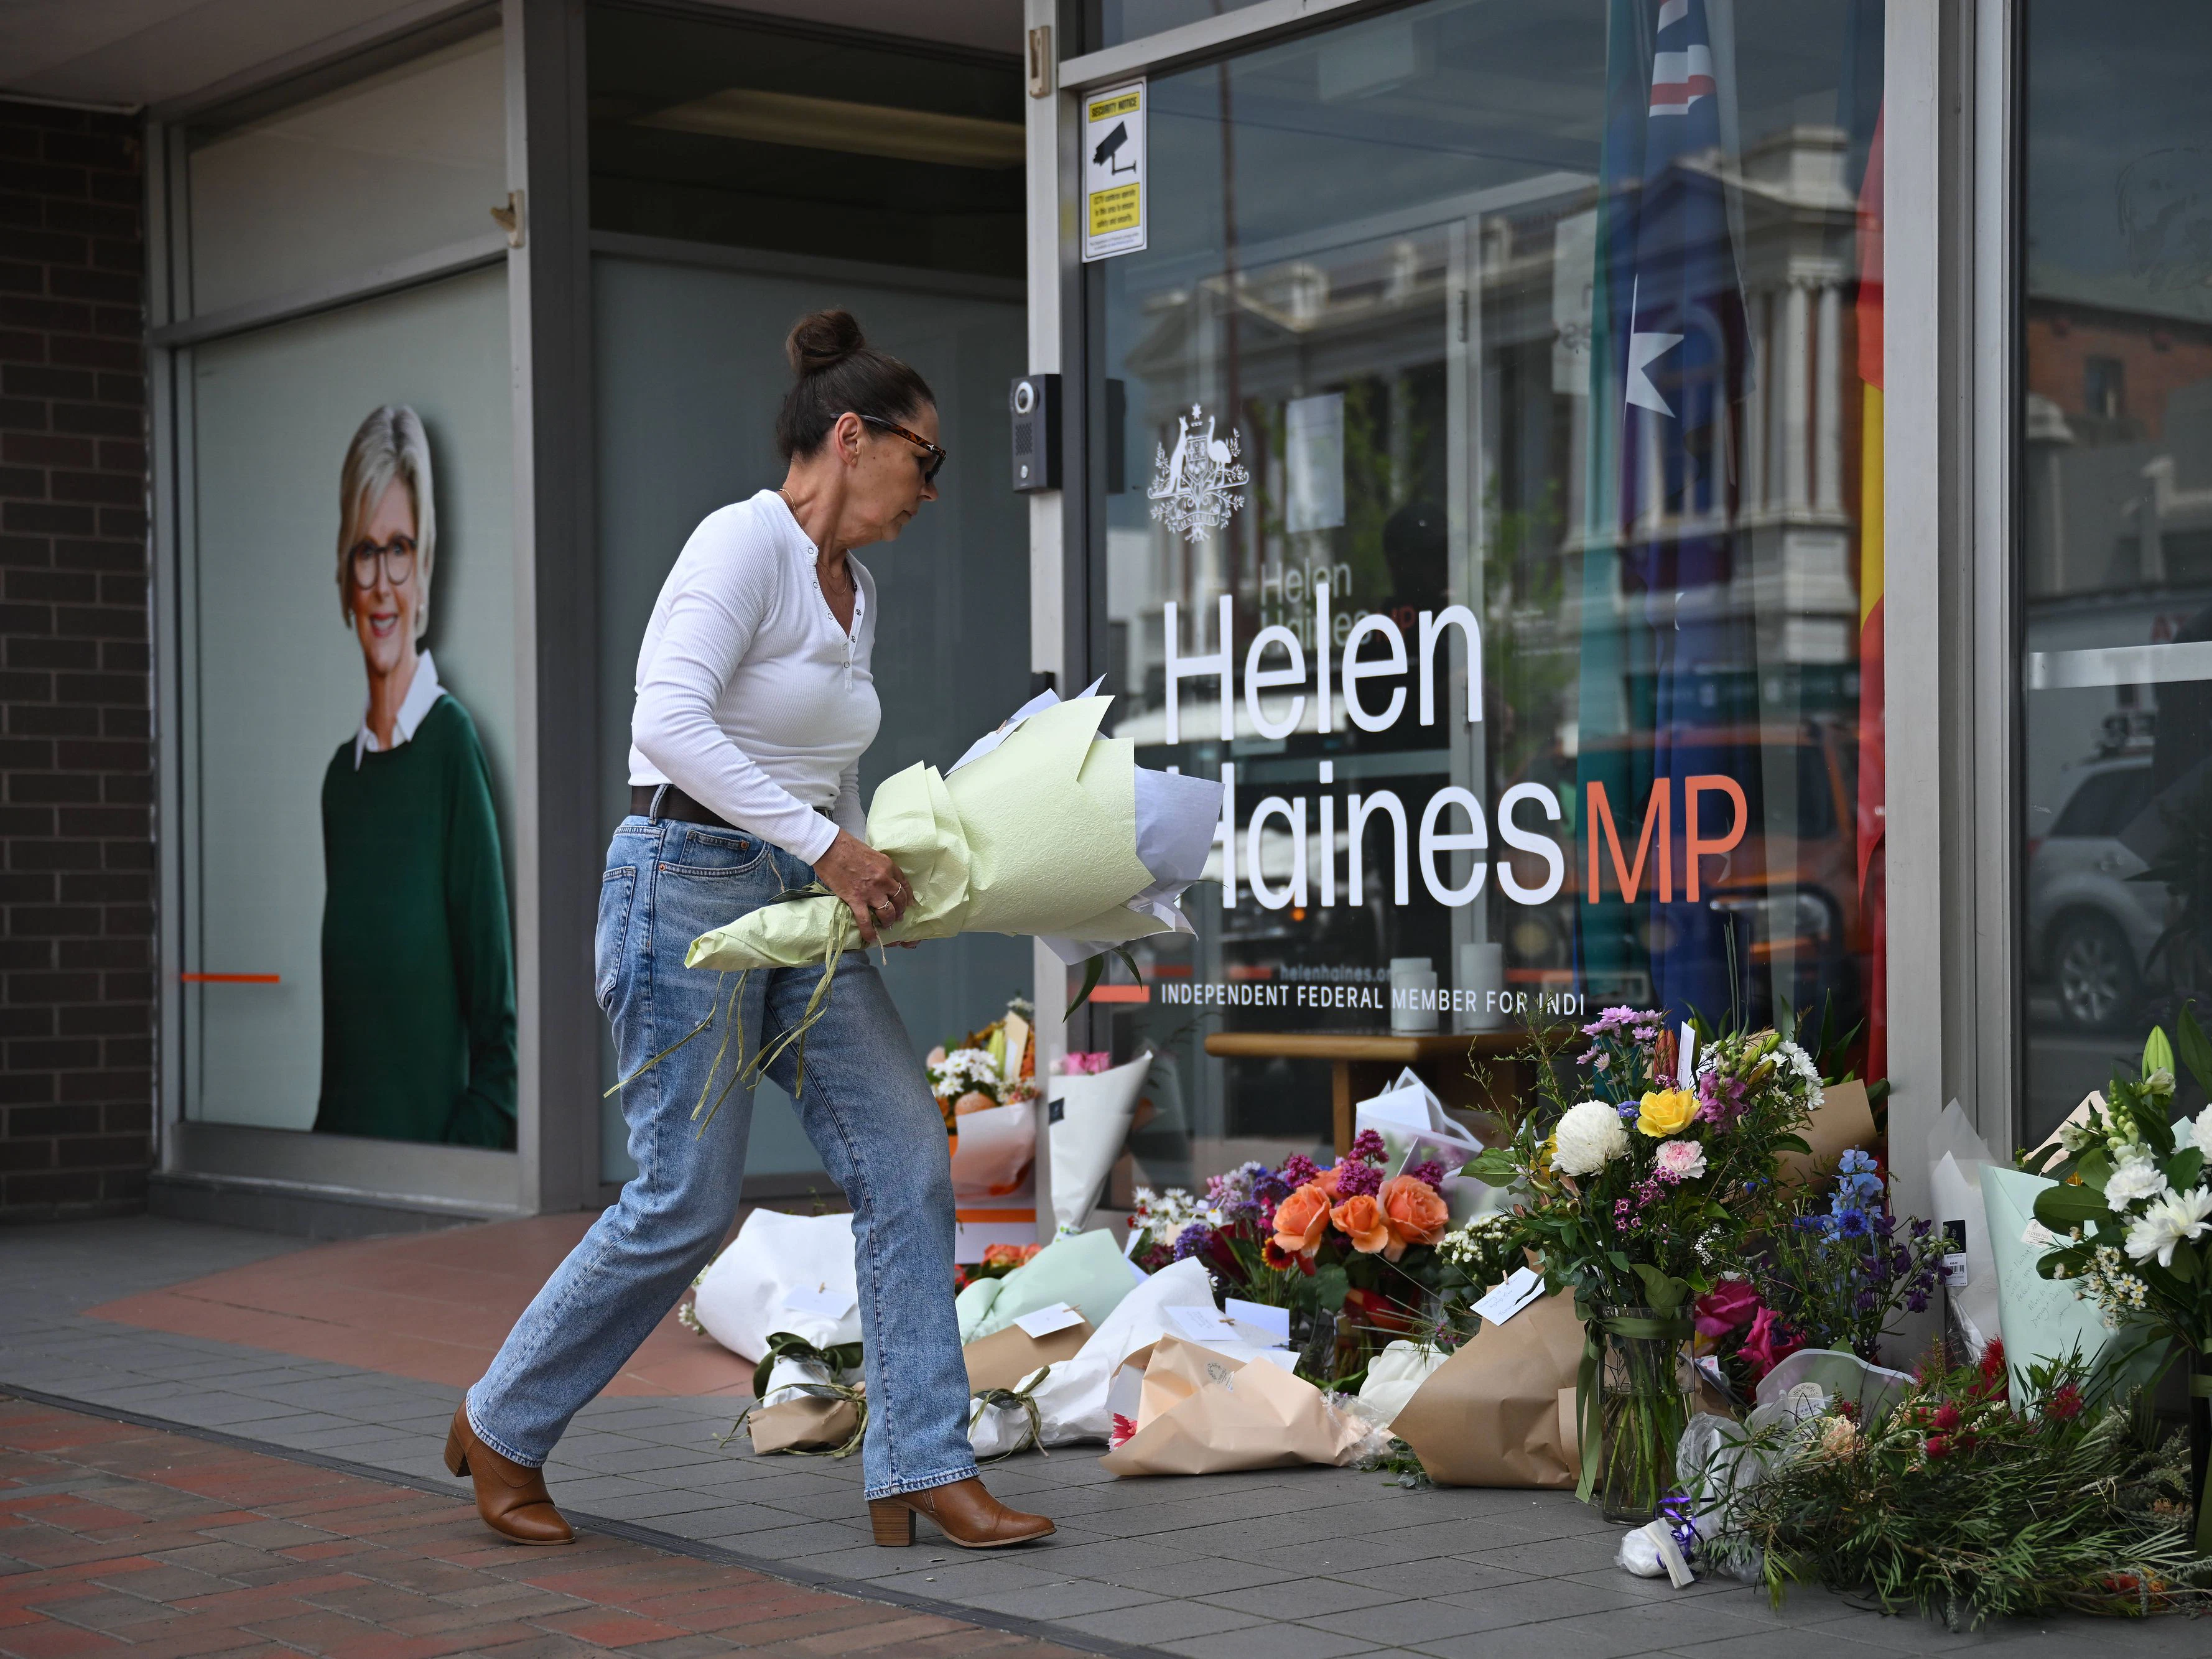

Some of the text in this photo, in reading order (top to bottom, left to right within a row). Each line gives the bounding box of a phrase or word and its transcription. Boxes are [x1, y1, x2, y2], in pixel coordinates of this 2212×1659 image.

[1091, 96, 1137, 118] SECURITY NOTICE
[1179, 514, 1216, 529] AUSTRALIA
[1163, 582, 1482, 745] Helen
[1586, 773, 1748, 904] MP
[1162, 984, 1584, 1016] INDEPENDENT FEDERAL MEMBER FOR INDI
